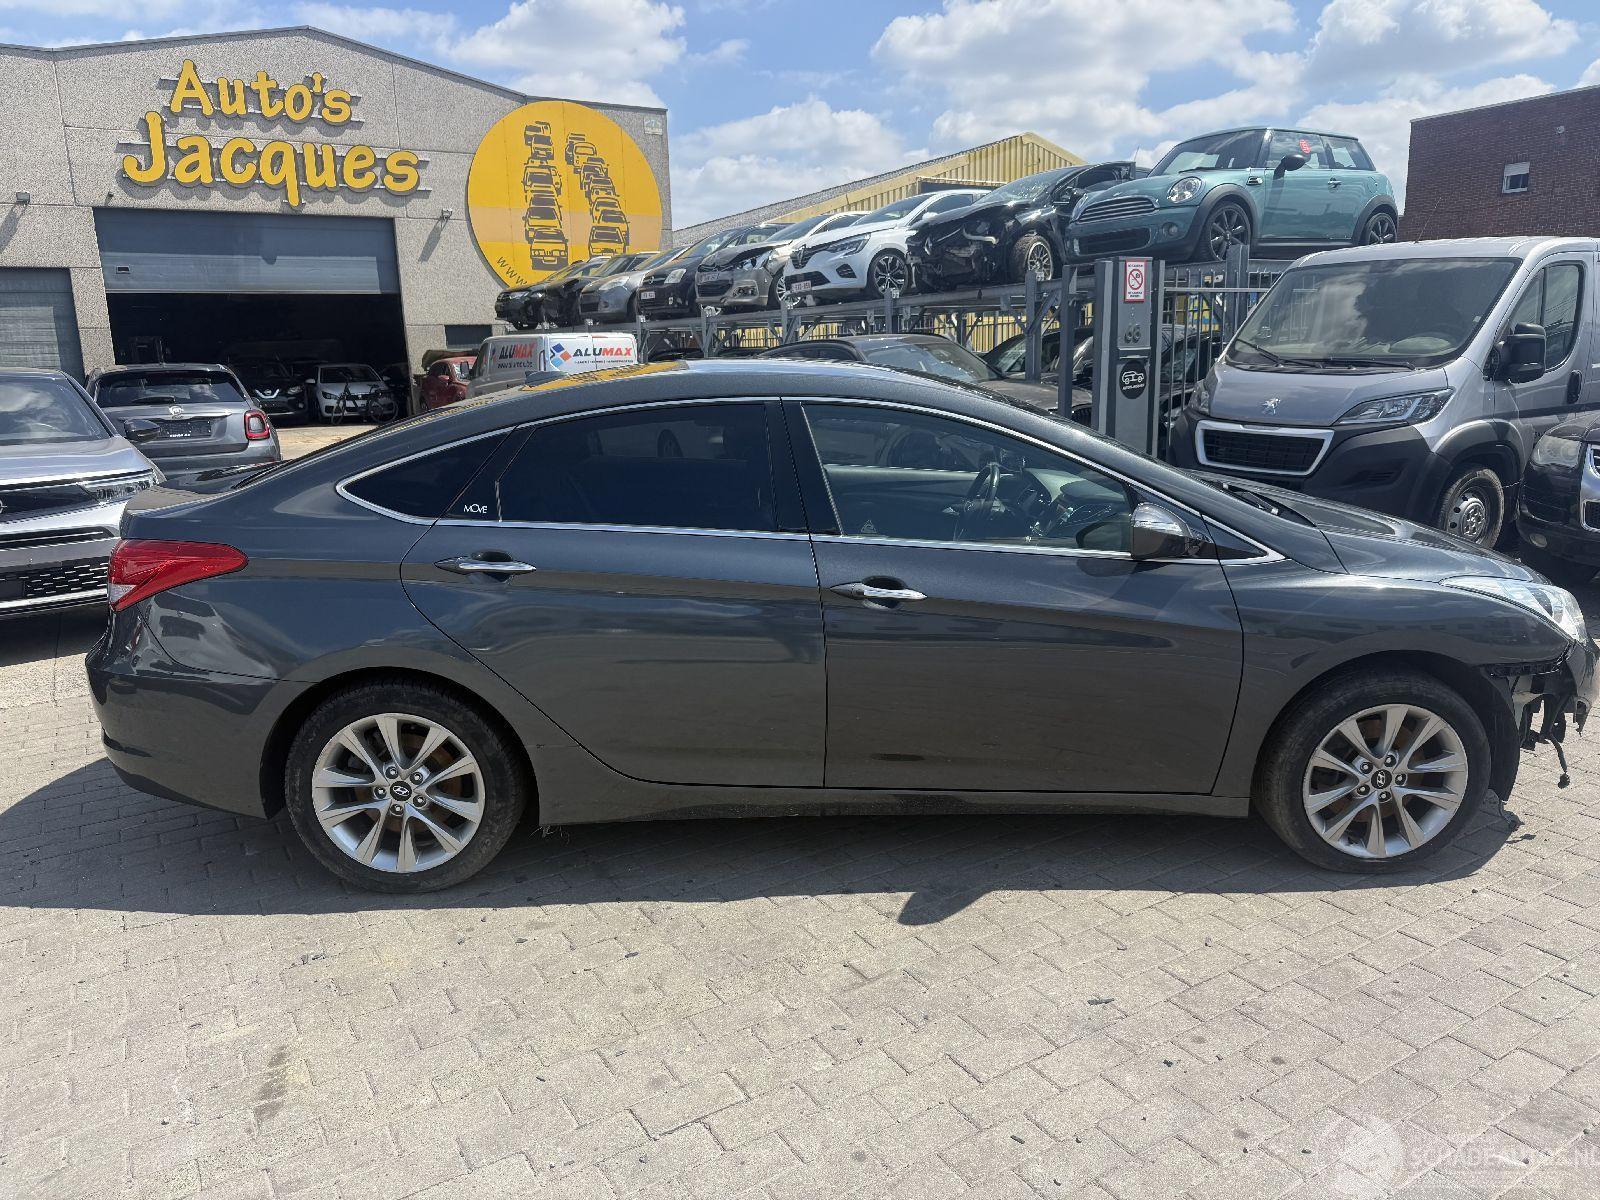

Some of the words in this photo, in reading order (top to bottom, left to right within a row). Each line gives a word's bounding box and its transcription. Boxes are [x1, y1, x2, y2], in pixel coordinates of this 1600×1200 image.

[170, 58, 352, 123] Auto's
[123, 110, 420, 206] Jacques
[500, 342, 536, 359] ALUMAX
[573, 347, 632, 357] ALUMAX
